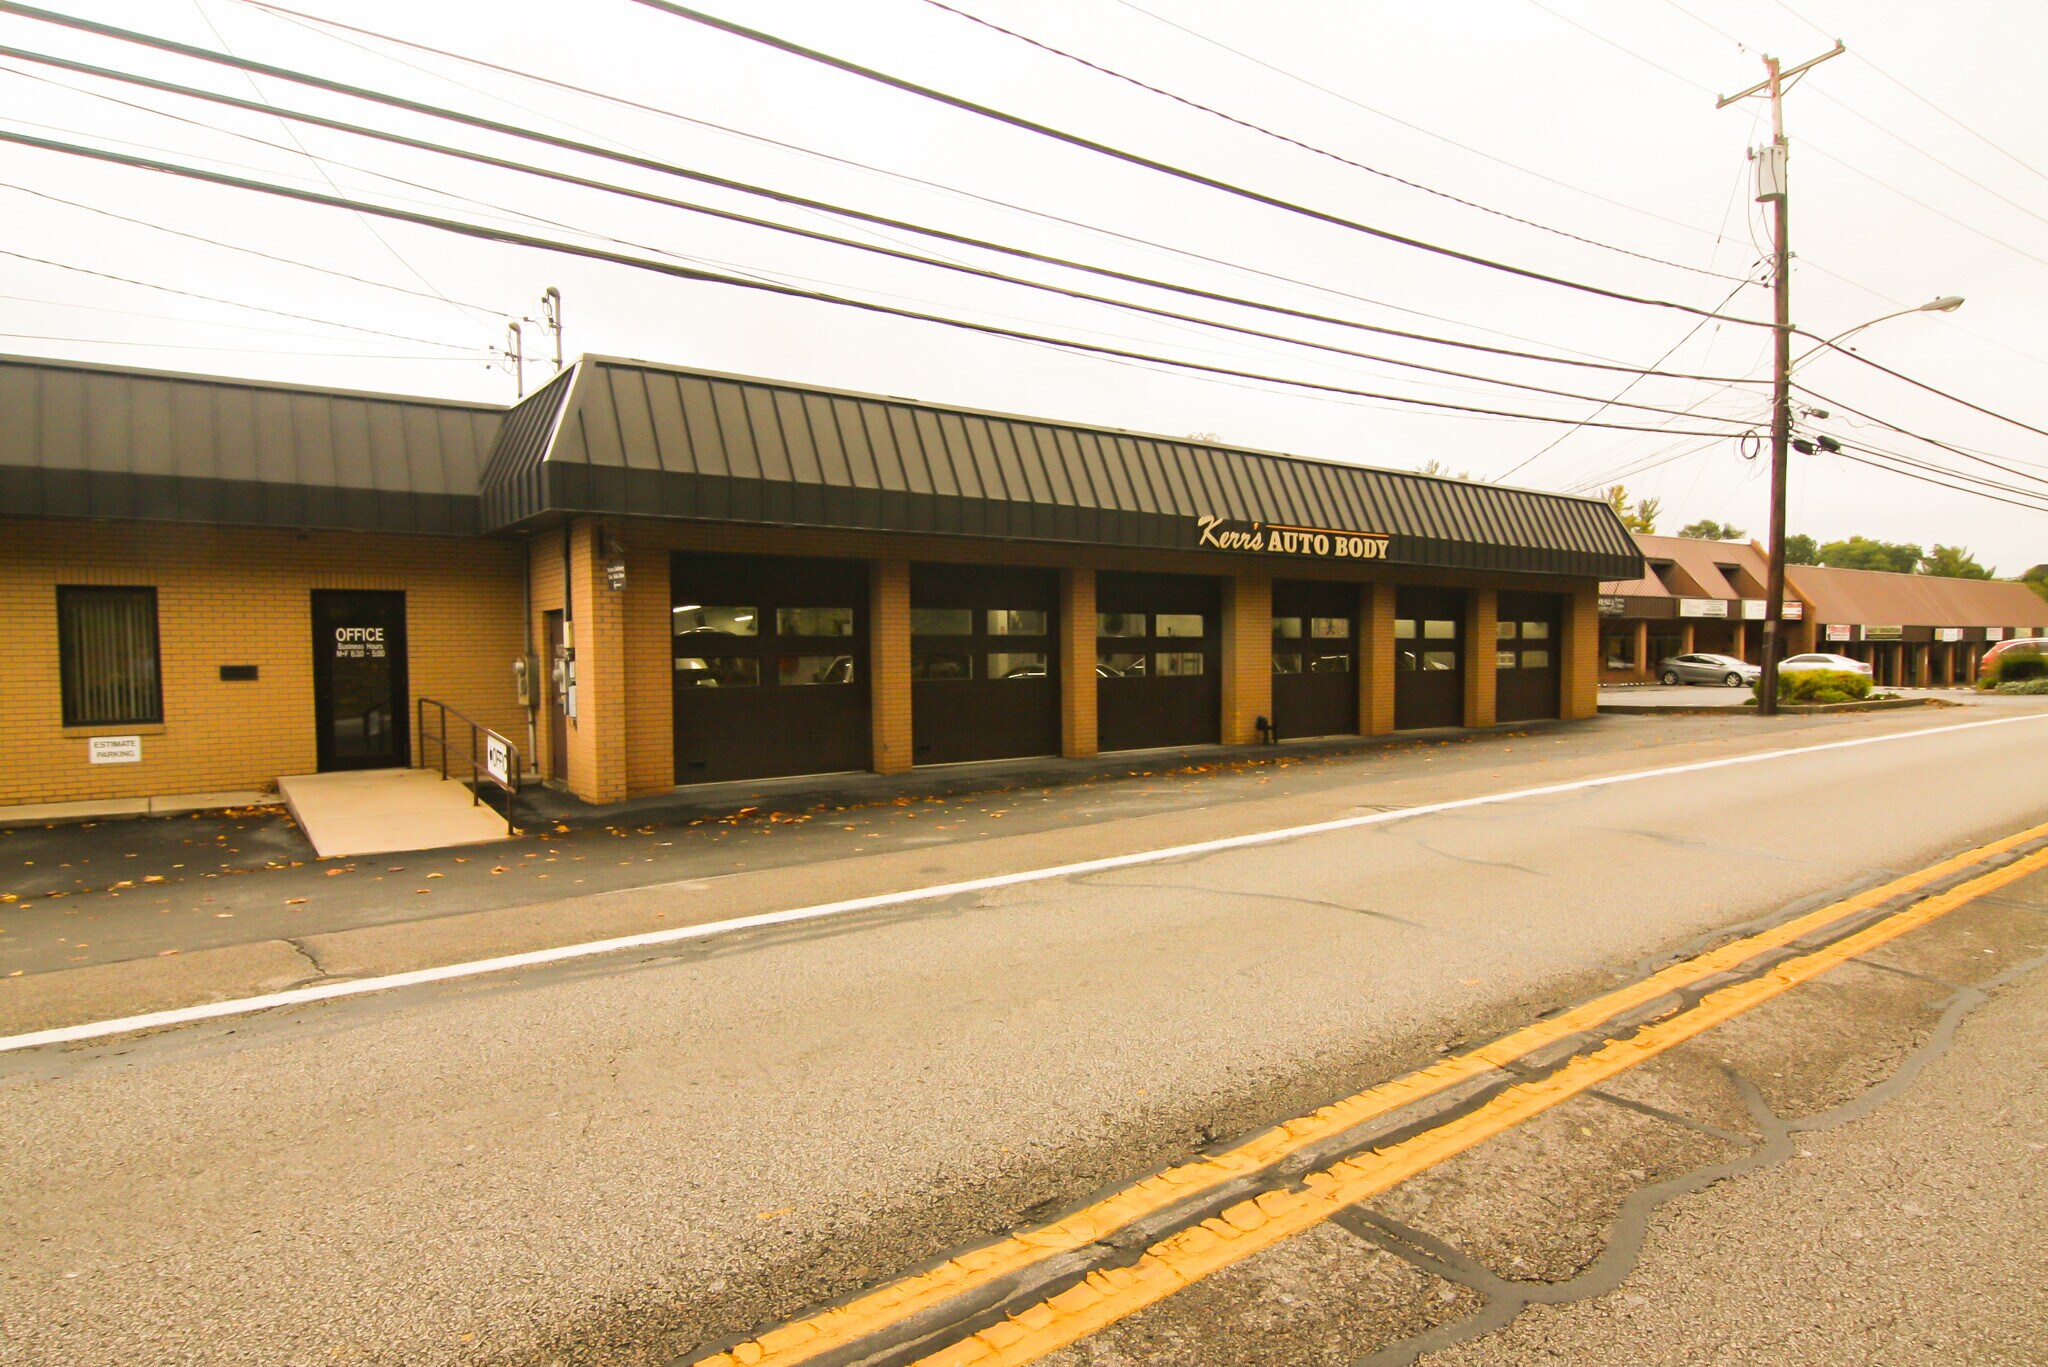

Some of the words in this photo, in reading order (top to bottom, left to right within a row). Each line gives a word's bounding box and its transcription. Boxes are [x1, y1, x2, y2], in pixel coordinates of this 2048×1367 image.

[1197, 514, 1264, 551] Kerr's
[1267, 530, 1330, 555] AUTO
[1335, 536, 1389, 560] BODY
[336, 627, 384, 641] OFFICE
[337, 642, 364, 650] Business
[366, 642, 384, 650] Hours
[371, 650, 386, 658] 5:00
[93, 740, 136, 749] ESTIMATE
[96, 750, 135, 758] PARKING
